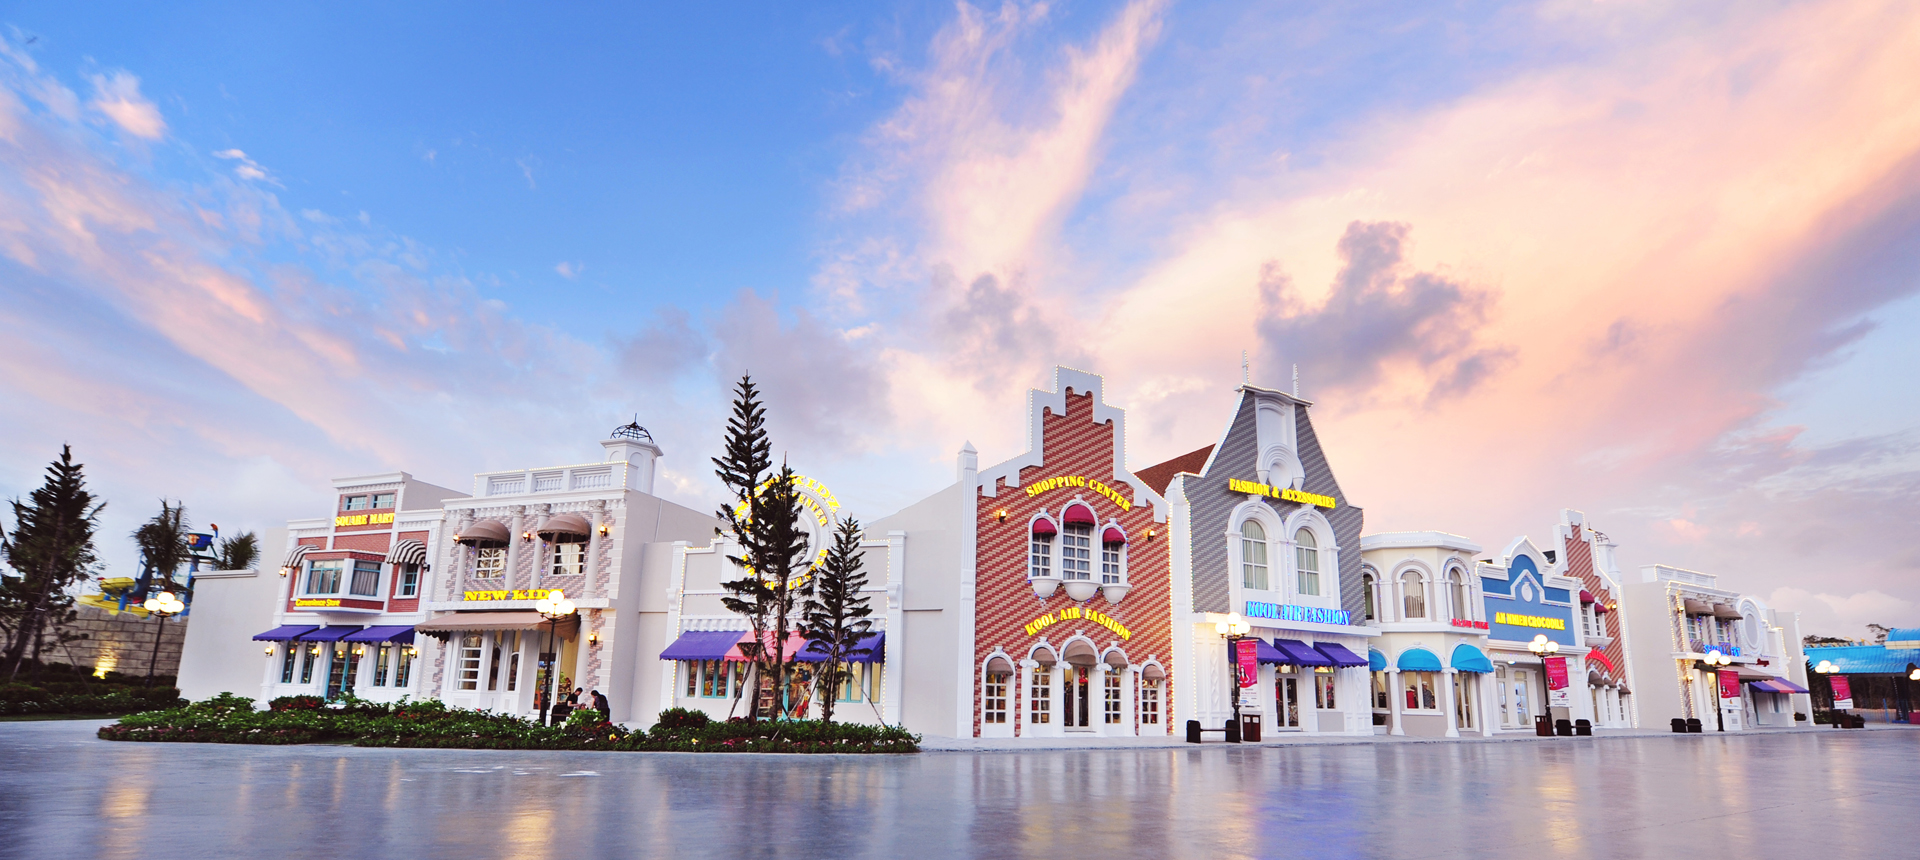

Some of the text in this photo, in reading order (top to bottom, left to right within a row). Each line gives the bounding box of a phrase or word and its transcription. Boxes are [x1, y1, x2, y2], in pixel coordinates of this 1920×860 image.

[1025, 475, 1131, 512] SHOPPING CENTER
[1229, 477, 1336, 509] FASHION & ACCESSORIES
[334, 512, 395, 527] SQUARE MART
[463, 588, 564, 601] NEW KID
[1024, 606, 1132, 641] KOOL AIR FASHION
[1246, 600, 1351, 626] KOOL AIR FASHION
[1495, 611, 1506, 624] AN
[1528, 615, 1565, 630] CROCODILE
